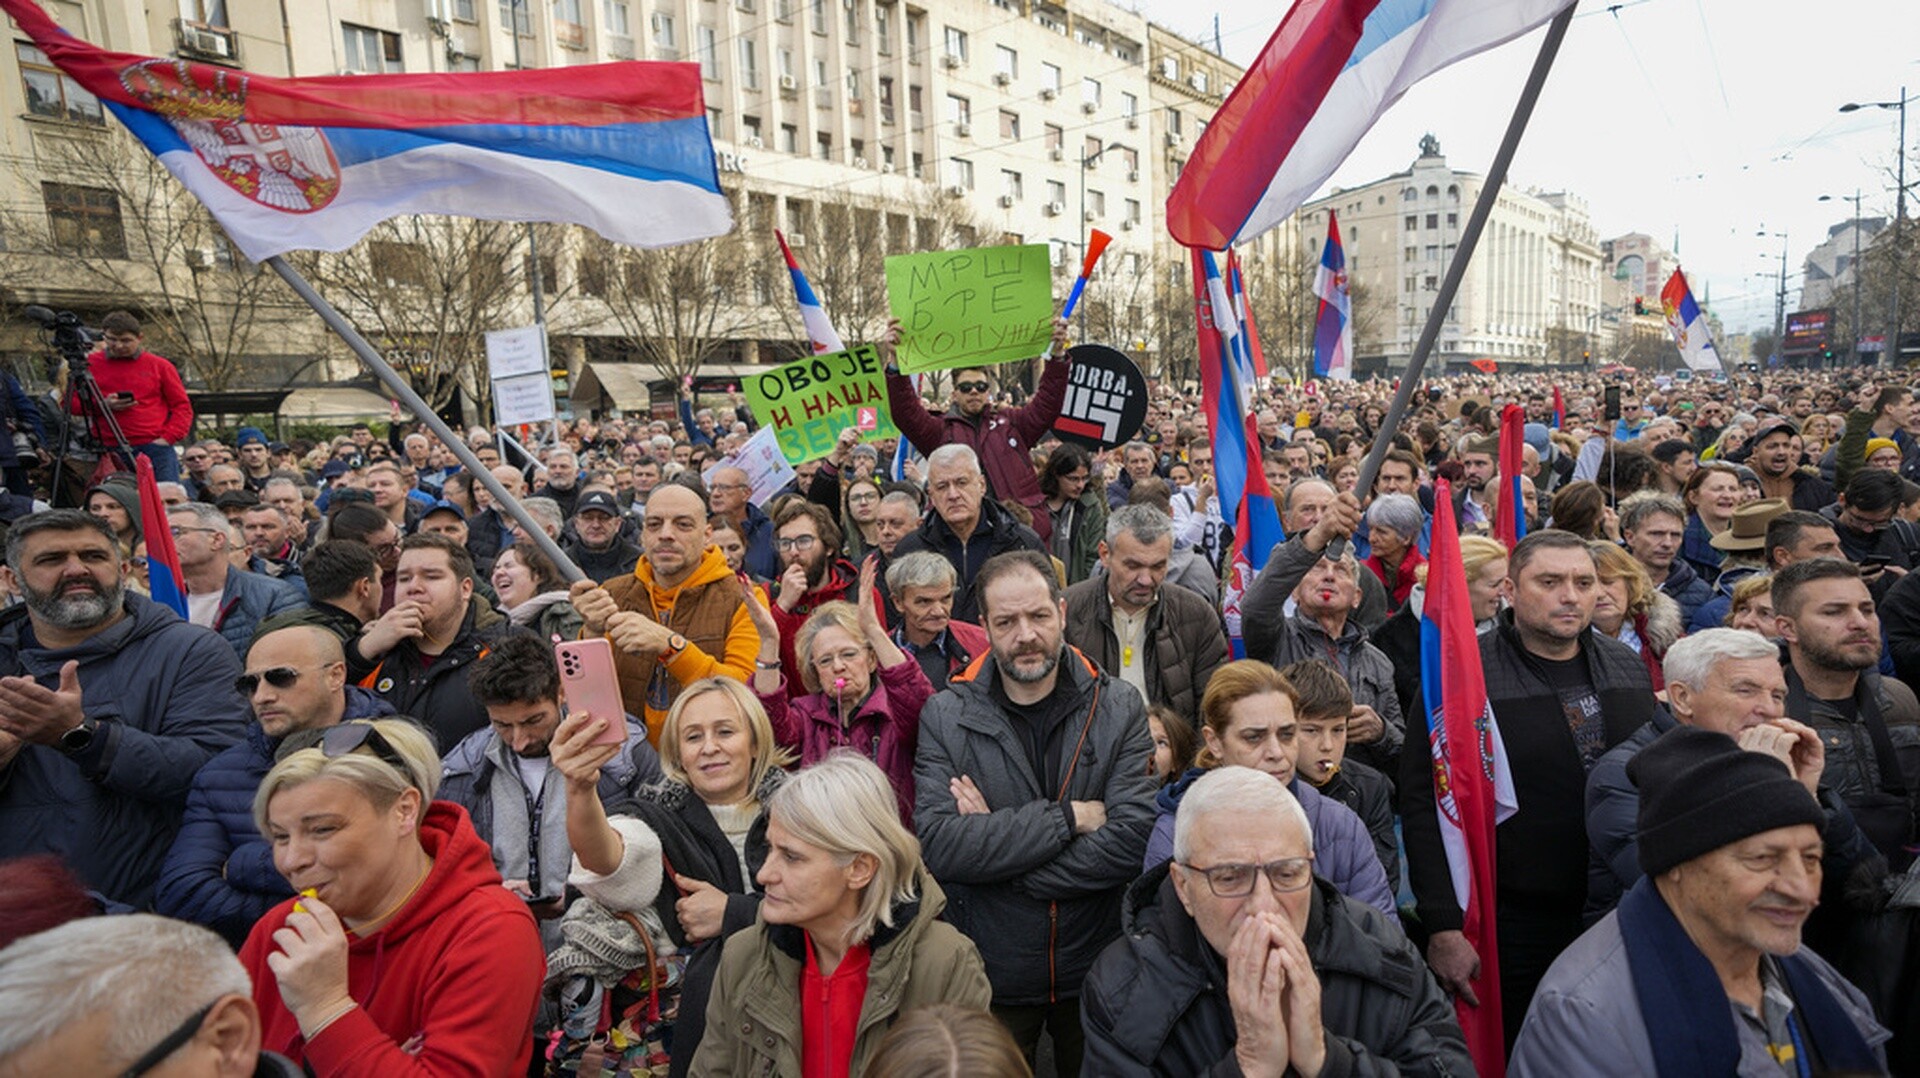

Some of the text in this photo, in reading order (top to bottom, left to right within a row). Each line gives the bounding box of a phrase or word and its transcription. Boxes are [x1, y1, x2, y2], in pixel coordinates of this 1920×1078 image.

[909, 252, 1022, 299] МРШ
[911, 279, 1023, 332] БРЕ
[759, 348, 877, 401] ОВО ЈЕ
[771, 380, 883, 430] И НАША
[779, 406, 895, 464] ЗЕМА
